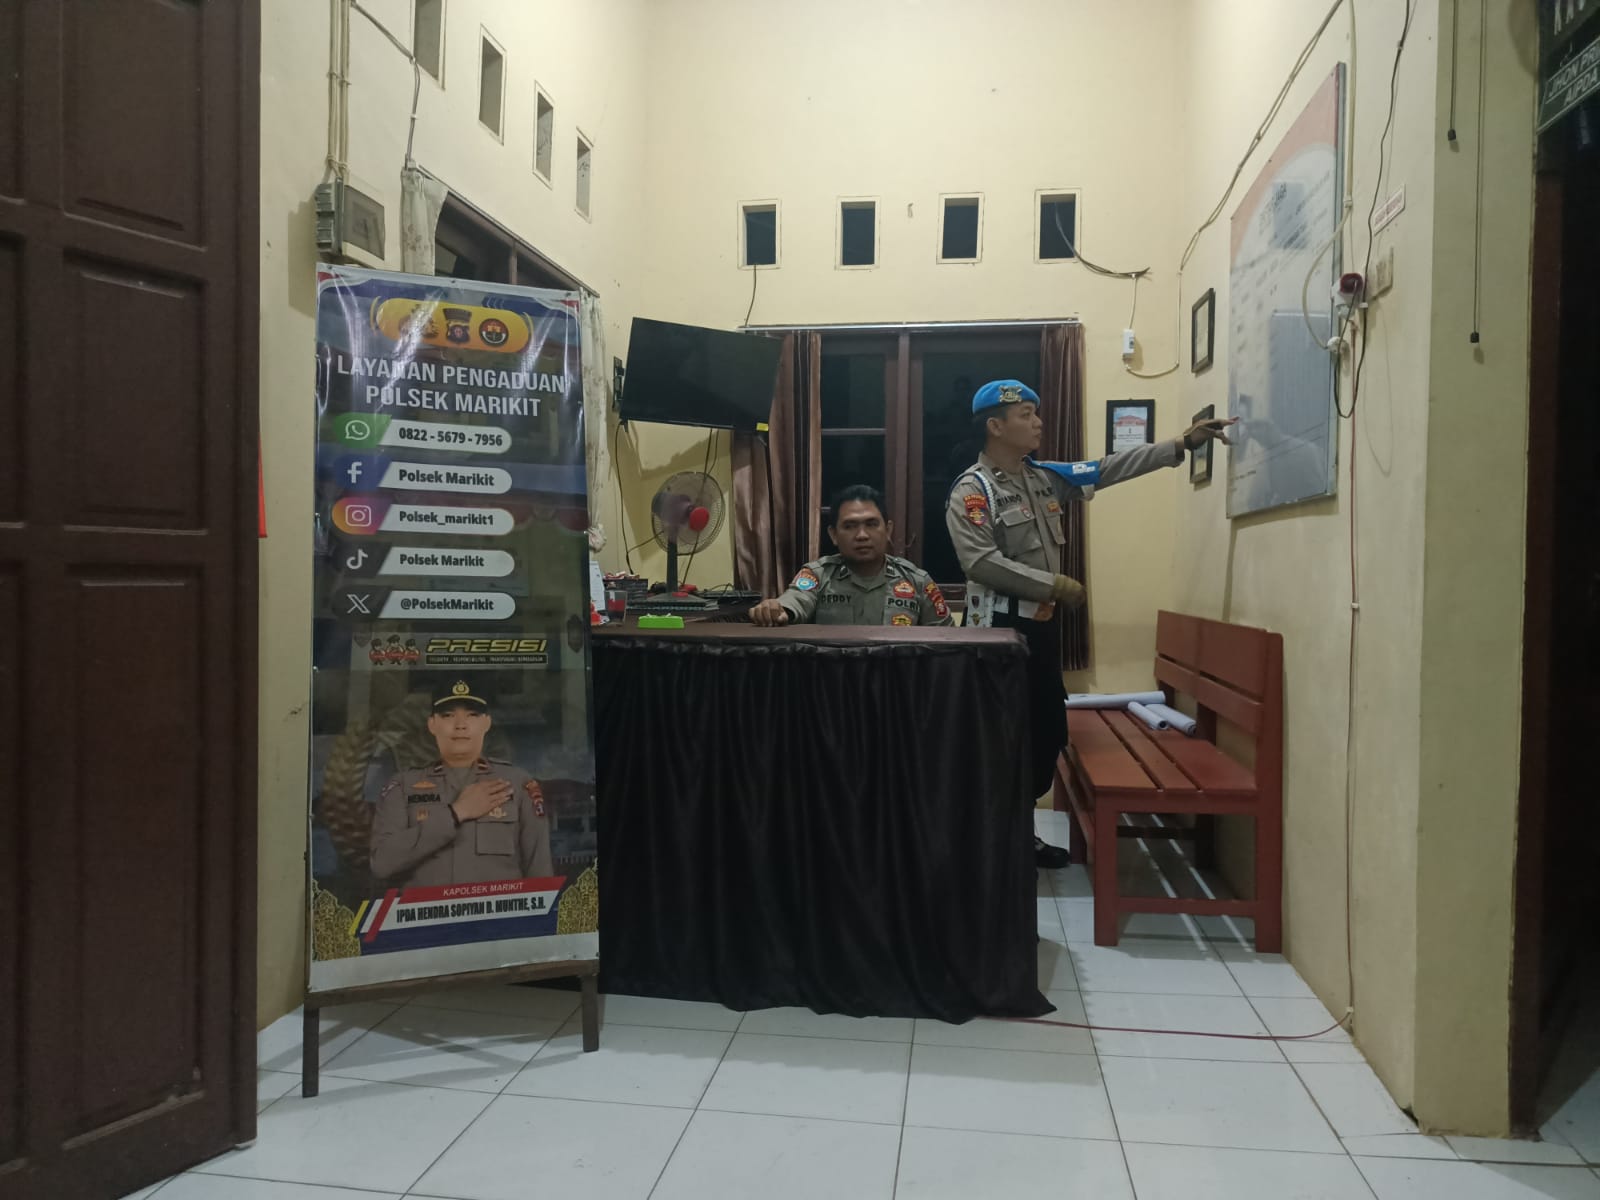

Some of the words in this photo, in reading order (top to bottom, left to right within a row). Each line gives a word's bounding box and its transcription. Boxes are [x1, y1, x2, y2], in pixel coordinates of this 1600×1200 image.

[337, 355, 437, 383] LAYANAN
[443, 365, 565, 393] PENGADUAN
[366, 385, 449, 411] POLSEK
[455, 393, 541, 417] MARIKIT
[399, 427, 428, 441] 0822
[437, 430, 466, 444] 5679
[474, 433, 503, 446] 7956
[399, 469, 443, 483] Polsek
[446, 472, 495, 486] Marikit
[399, 510, 494, 526] Polsek_marikit1
[399, 554, 439, 567] Polsek
[441, 555, 485, 567] Marikit
[400, 598, 494, 611] @PolsekMarikit
[821, 594, 852, 605] DEDDY
[888, 597, 919, 613] POLRI
[426, 639, 547, 653] PRESISI
[443, 886, 488, 897] KAPOLSEK
[490, 882, 524, 892] MARIKIT
[397, 909, 416, 923] IPDA
[417, 904, 450, 920] HENDRA
